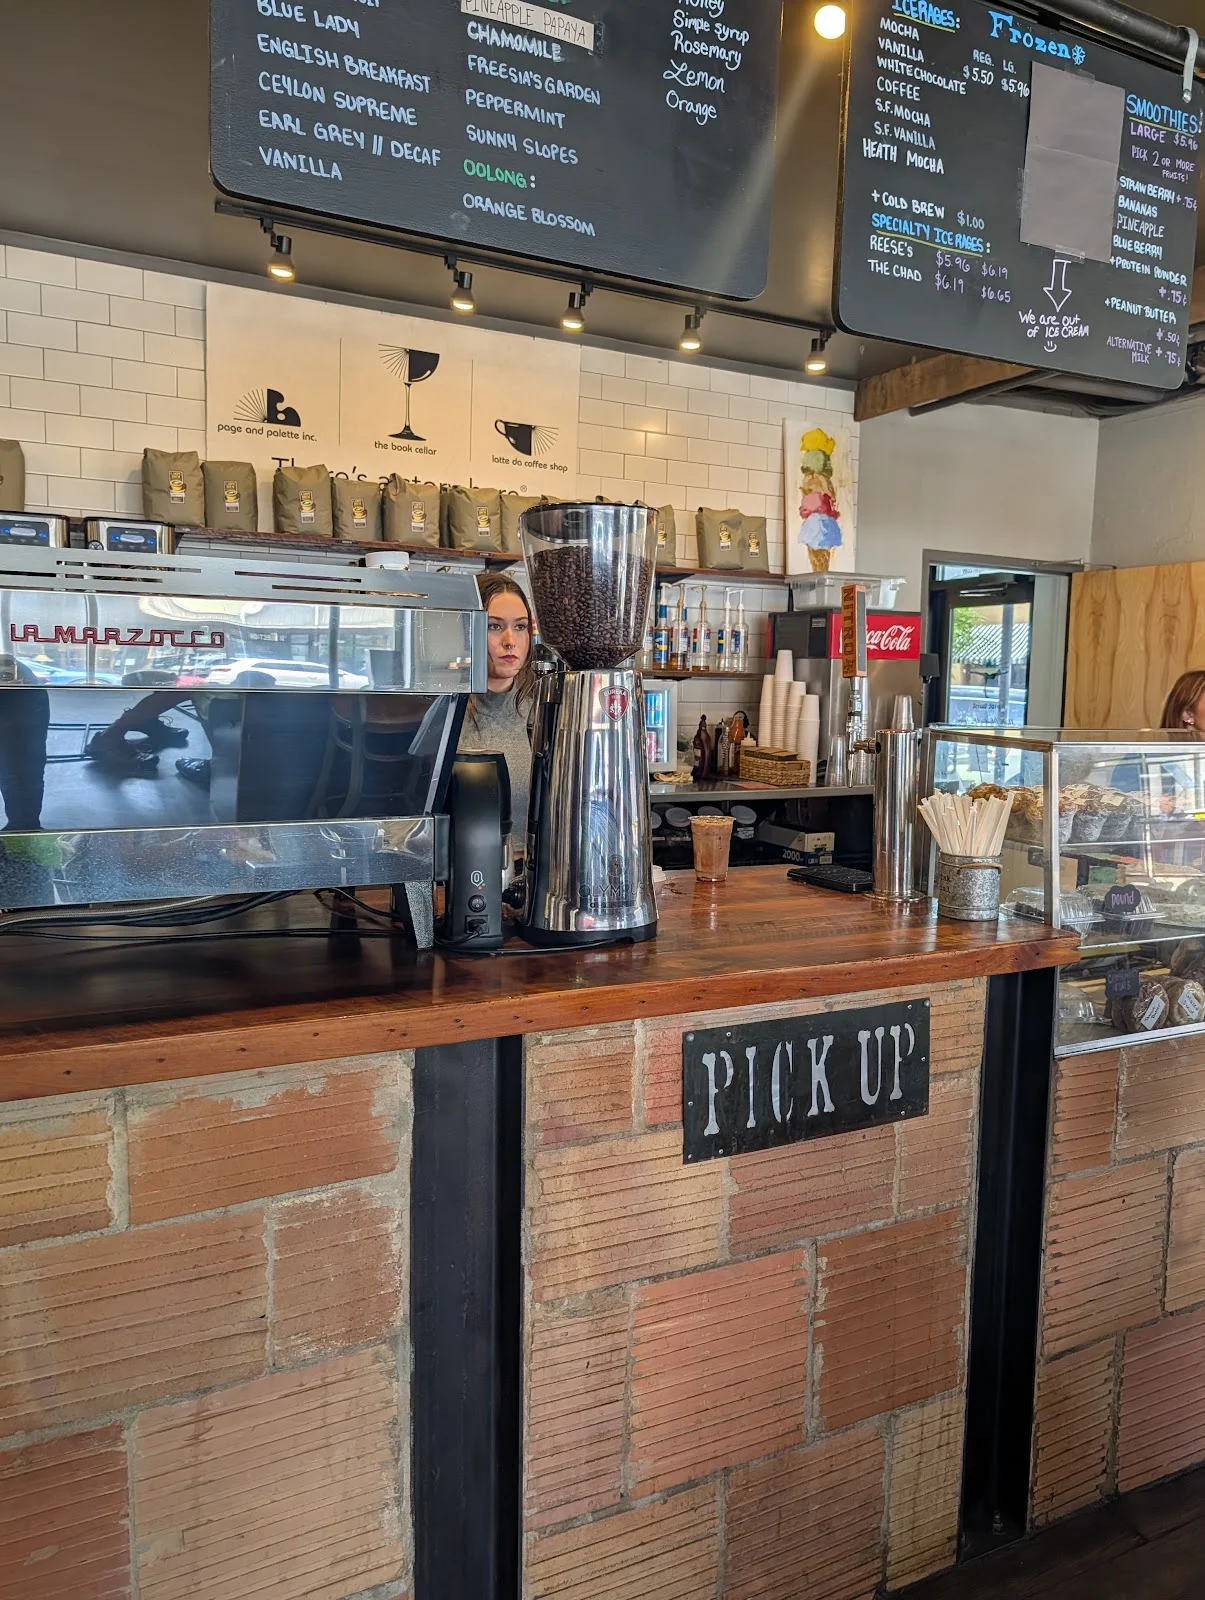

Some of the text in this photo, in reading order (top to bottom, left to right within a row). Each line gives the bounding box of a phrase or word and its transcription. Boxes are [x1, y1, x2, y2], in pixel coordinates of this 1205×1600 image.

[257, 0, 360, 39] BLUE LADY
[679, 0, 725, 18] oney
[467, 20, 562, 62] CHAMOMILE
[543, 12, 586, 45] PAPAYA
[673, 9, 750, 46] Simple syrup
[880, 17, 920, 41] MOCHA
[988, 10, 1071, 59] Frozen
[670, 30, 742, 70] Rosemary
[878, 37, 924, 62] VANILLA
[257, 34, 431, 94] ENGLISH BREAKFAST
[662, 59, 725, 93] Lemon
[468, 54, 601, 105] FREESIA'S GARDEN
[876, 76, 921, 102] COFFEE
[258, 72, 418, 126] CEYLON SUPREME
[466, 89, 566, 129] PEPPERMINT
[666, 90, 718, 126] Orange
[258, 110, 306, 136] EARL
[314, 122, 365, 150] GREY
[390, 140, 441, 166] DECAF
[466, 124, 578, 165] SUNNY SLOPES
[894, 126, 936, 150] VANILLA
[1130, 122, 1166, 144] LARGE
[258, 146, 342, 180] VANILLA
[862, 138, 944, 175] HEATH MOCHA
[1132, 145, 1196, 172] PICK 2 OR MORE
[1119, 176, 1176, 204] STRAWBERRY
[462, 193, 596, 237] ORANGE BLOSSOM
[912, 200, 945, 219] BREW
[957, 210, 985, 231] $1.00
[1118, 195, 1158, 218] BANANAS
[871, 213, 931, 240] SPECIALTY
[1117, 213, 1165, 238] PINEAPPLE
[1113, 234, 1163, 260] BLUEBERRY
[868, 260, 890, 276] THE
[892, 264, 922, 282] CHAD
[1018, 309, 1081, 326] We are out
[1026, 325, 1090, 338] of ICE CREAM
[1106, 336, 1152, 355] ALTERNATIVE
[1131, 352, 1150, 364] MILK
[217, 423, 318, 442] page and palette inc.
[374, 440, 438, 456] the book cellar
[492, 454, 569, 474] latte da coffee shop
[11, 624, 38, 642] LA
[844, 588, 854, 656] NITRO
[782, 848, 800, 862] 2000
[702, 1022, 916, 1136] PICK UP
